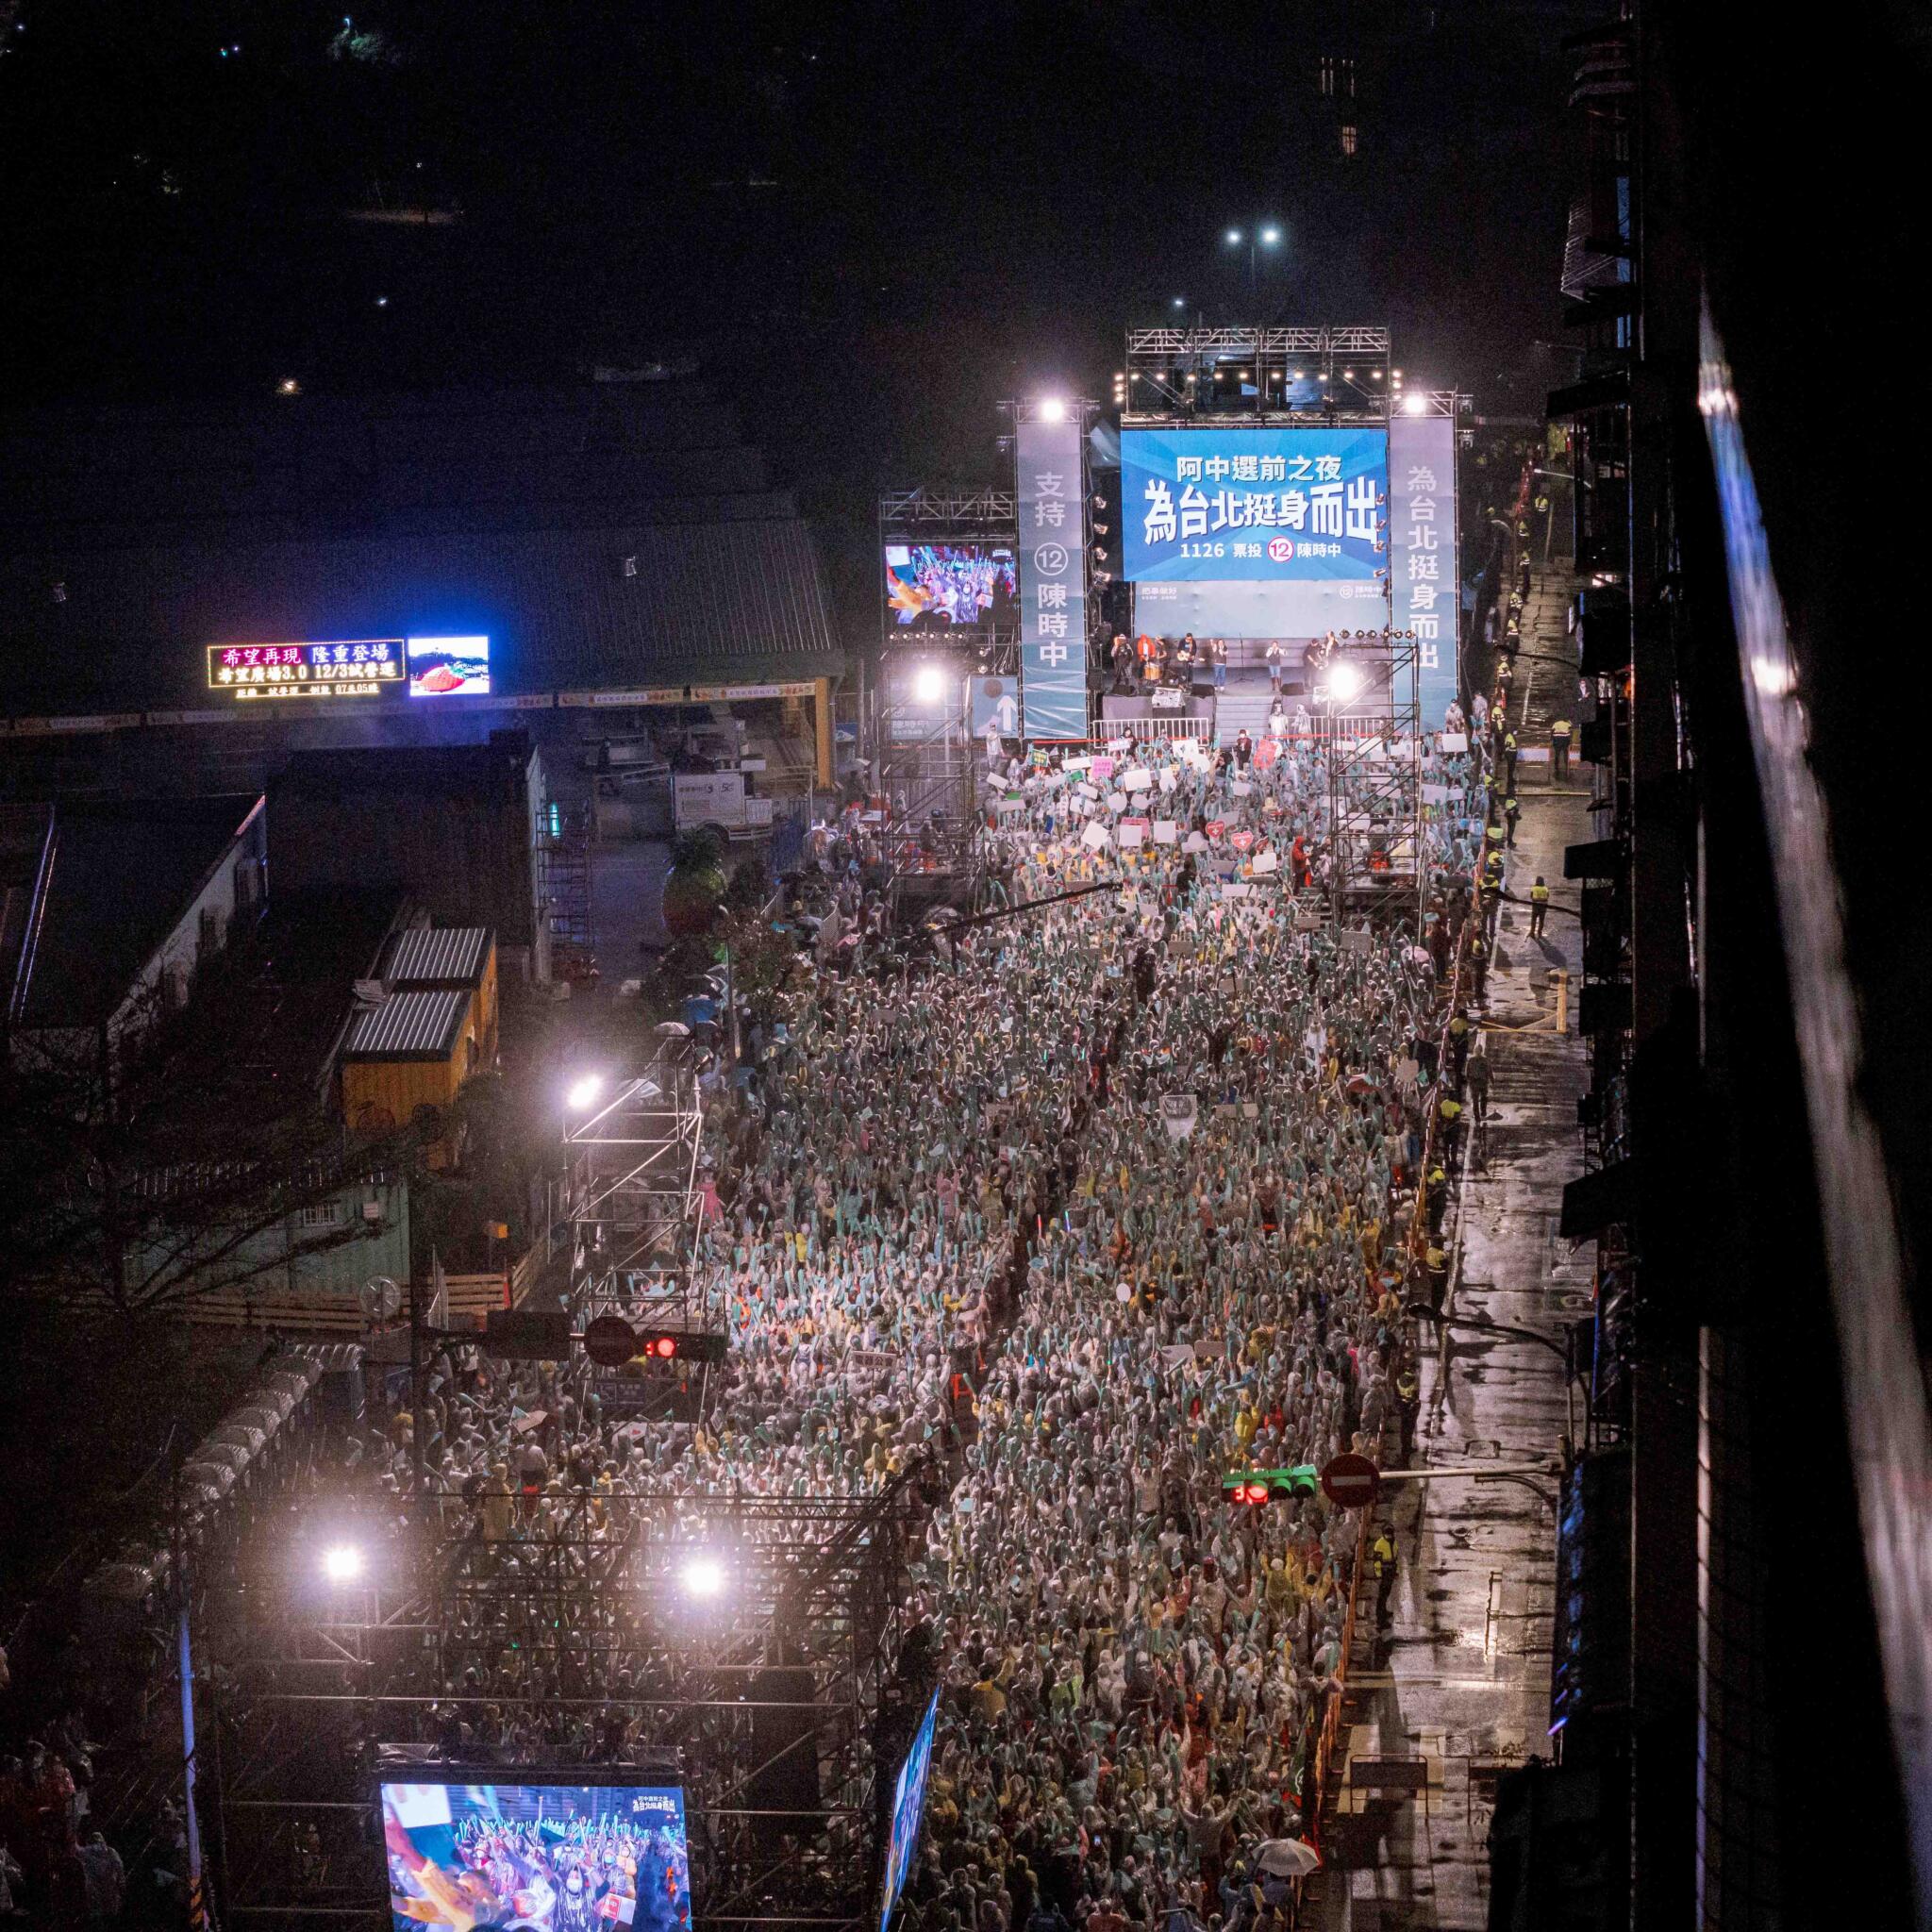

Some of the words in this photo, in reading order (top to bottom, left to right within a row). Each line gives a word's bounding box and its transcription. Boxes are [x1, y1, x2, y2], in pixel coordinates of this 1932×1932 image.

[1176, 455, 1342, 483] 阿中選前之夜
[1035, 472, 1066, 527] 支持
[1142, 476, 1377, 545] 為台北挺身而出
[1179, 542, 1225, 558] 1126
[1232, 542, 1263, 558] 票投
[1269, 541, 1292, 560] 12
[1297, 542, 1342, 558] 陳時中
[1407, 466, 1440, 669] 為台北挺身而出
[1038, 582, 1068, 668] 陳時中
[223, 647, 302, 668] 希望再現
[311, 642, 390, 663] 隆重登場
